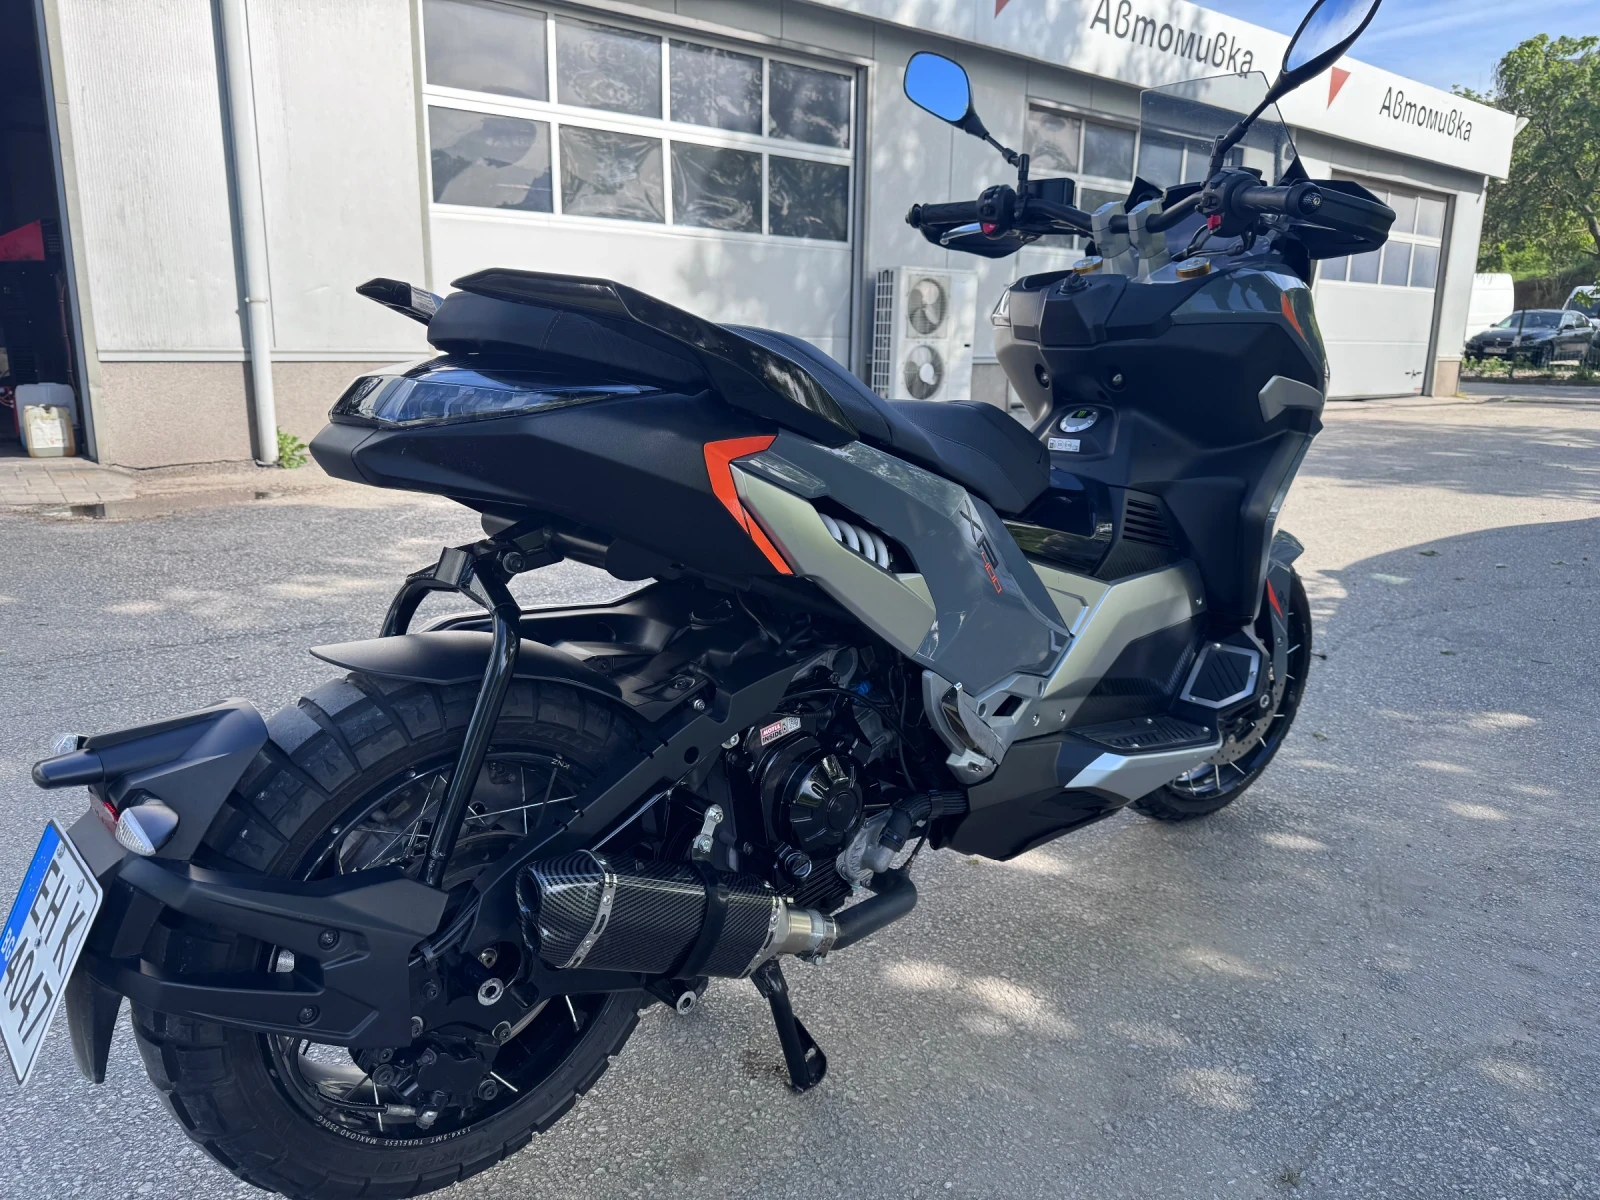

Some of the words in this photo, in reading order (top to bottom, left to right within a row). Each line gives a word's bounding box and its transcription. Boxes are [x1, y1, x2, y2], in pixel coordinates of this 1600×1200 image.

[1090, 0, 1254, 79] Автомивка
[1379, 86, 1472, 142] Автомивка
[2, 927, 16, 960] BG
[3, 936, 54, 1046] 4047
[384, 1139, 425, 1147] TUBELESS
